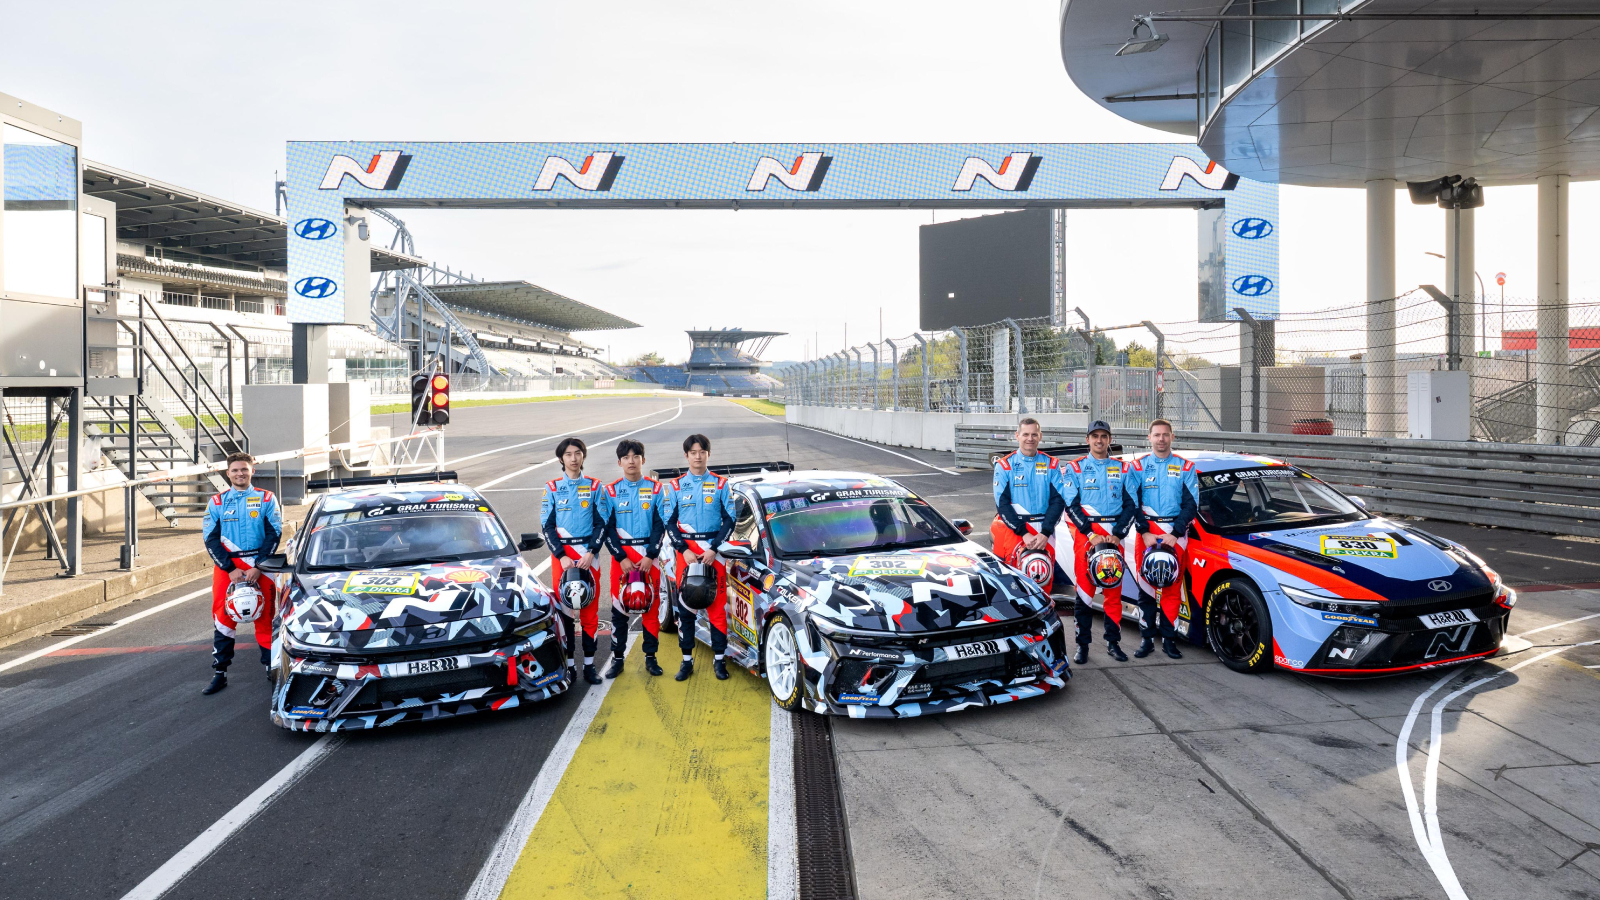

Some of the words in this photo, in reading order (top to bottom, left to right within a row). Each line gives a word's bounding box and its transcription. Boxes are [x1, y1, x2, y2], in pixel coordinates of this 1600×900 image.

[397, 503, 427, 511] GRAN
[1338, 540, 1379, 549] 830
[1345, 550, 1391, 558] DEKRA
[869, 560, 907, 569] 302
[362, 576, 402, 585] 303
[1205, 582, 1231, 625] GOODYEAR
[735, 596, 749, 625] 302
[1324, 615, 1375, 624] GOODYEAR
[1428, 612, 1455, 625] H&R
[862, 650, 900, 659] Performance
[955, 642, 984, 657] H&R
[1249, 642, 1265, 667] EAGLE
[1274, 655, 1304, 666] sparco
[408, 661, 439, 675] H&R
